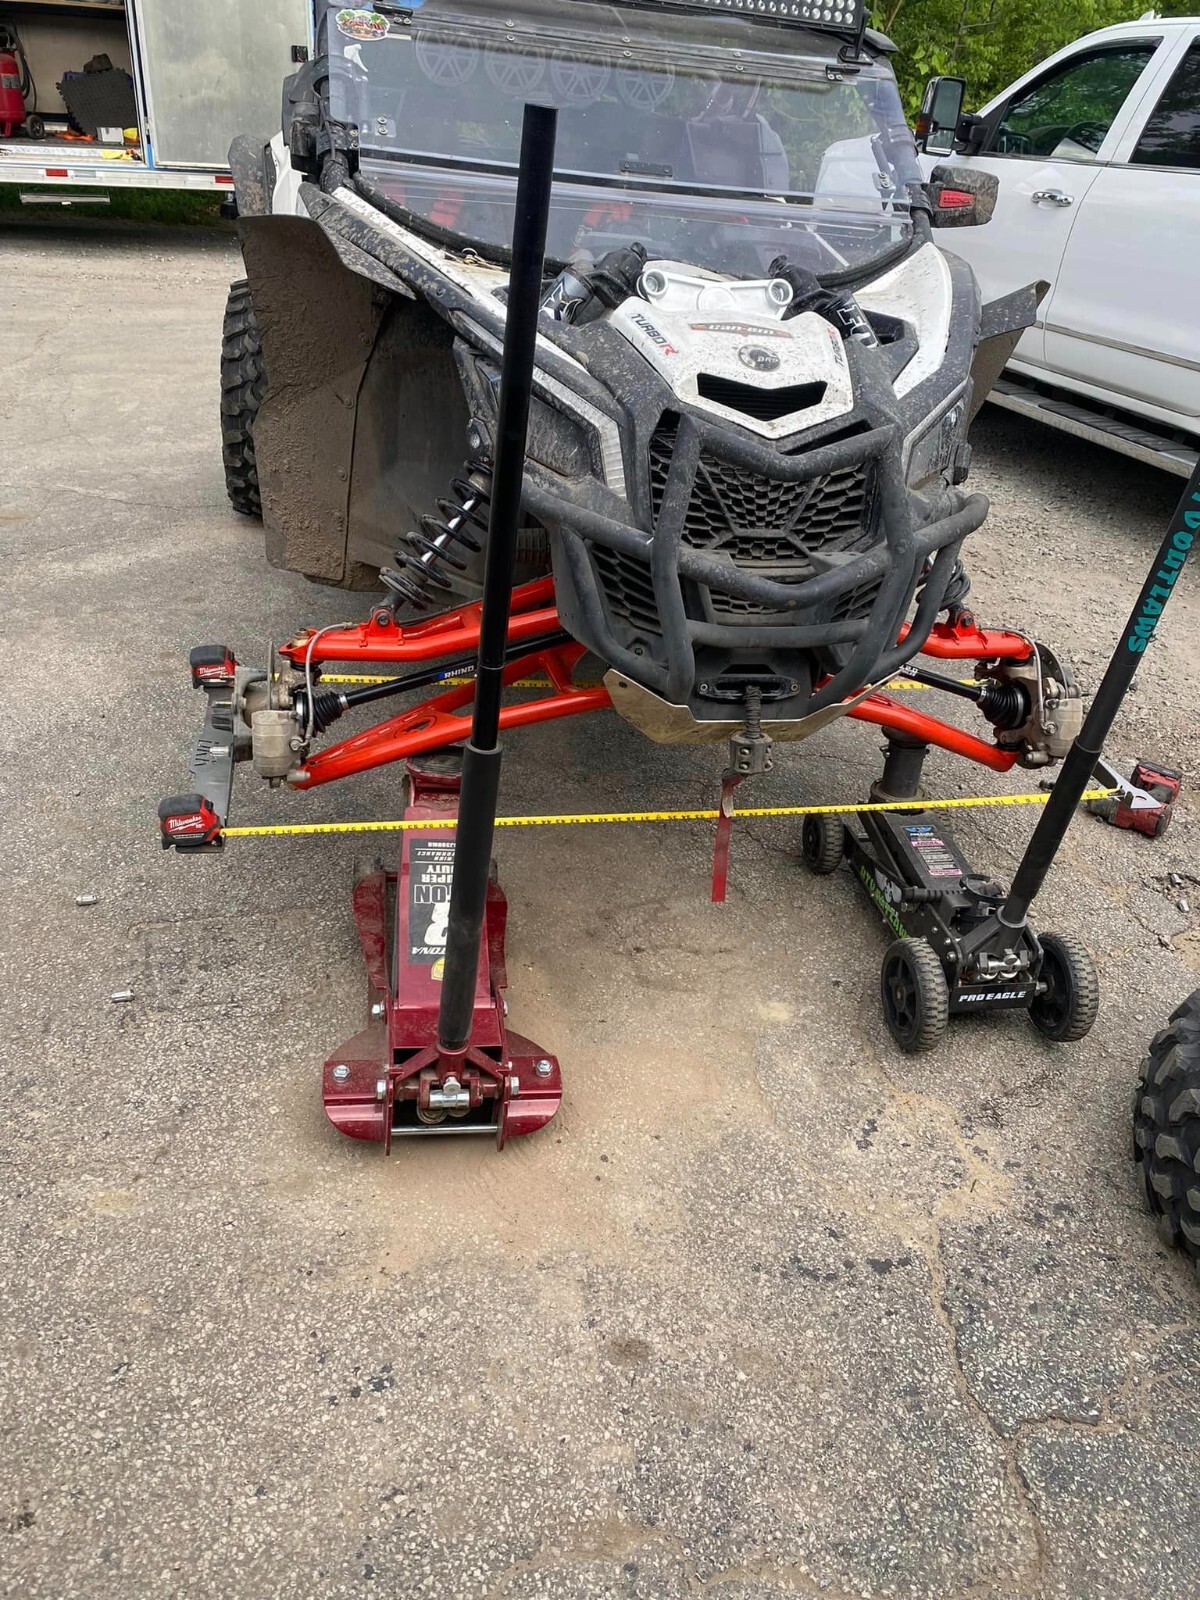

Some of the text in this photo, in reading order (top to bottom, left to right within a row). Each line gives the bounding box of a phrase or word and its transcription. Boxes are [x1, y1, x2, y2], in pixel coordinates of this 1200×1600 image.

[837, 304, 878, 348] FO
[1128, 531, 1194, 653] OUTLAWS
[444, 665, 475, 678] RHINO
[168, 815, 202, 829] Milwaukee
[421, 874, 453, 884] UPER
[874, 887, 910, 940] OUTLAW
[412, 946, 446, 955] TONA
[958, 990, 1028, 1003] PRO EAGLE
